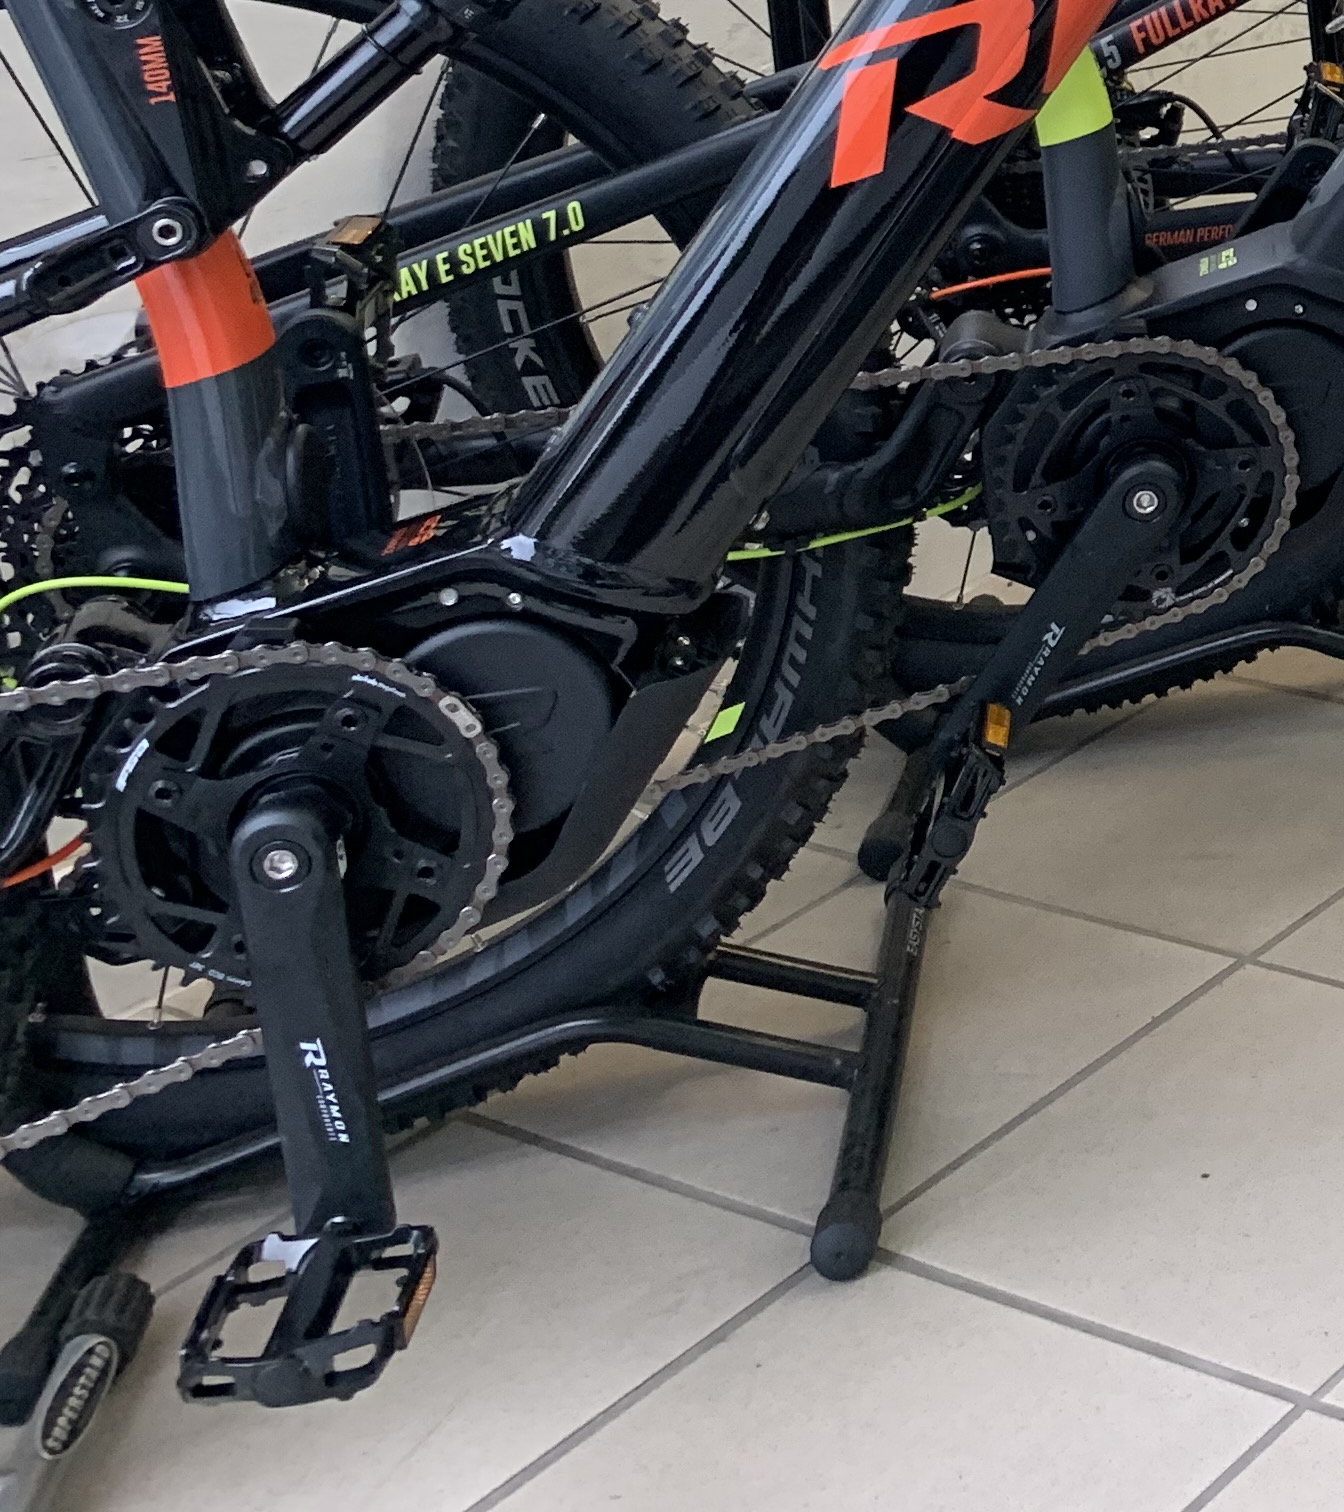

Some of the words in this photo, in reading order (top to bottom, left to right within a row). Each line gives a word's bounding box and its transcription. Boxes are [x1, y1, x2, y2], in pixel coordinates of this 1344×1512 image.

[135, 34, 177, 106] 140MM
[435, 251, 455, 284] E
[457, 218, 537, 276] SEVEN
[541, 200, 585, 242] 7.0
[317, 1069, 350, 1143] RAYMON
[45, 1344, 111, 1451] SUPERSTAND
